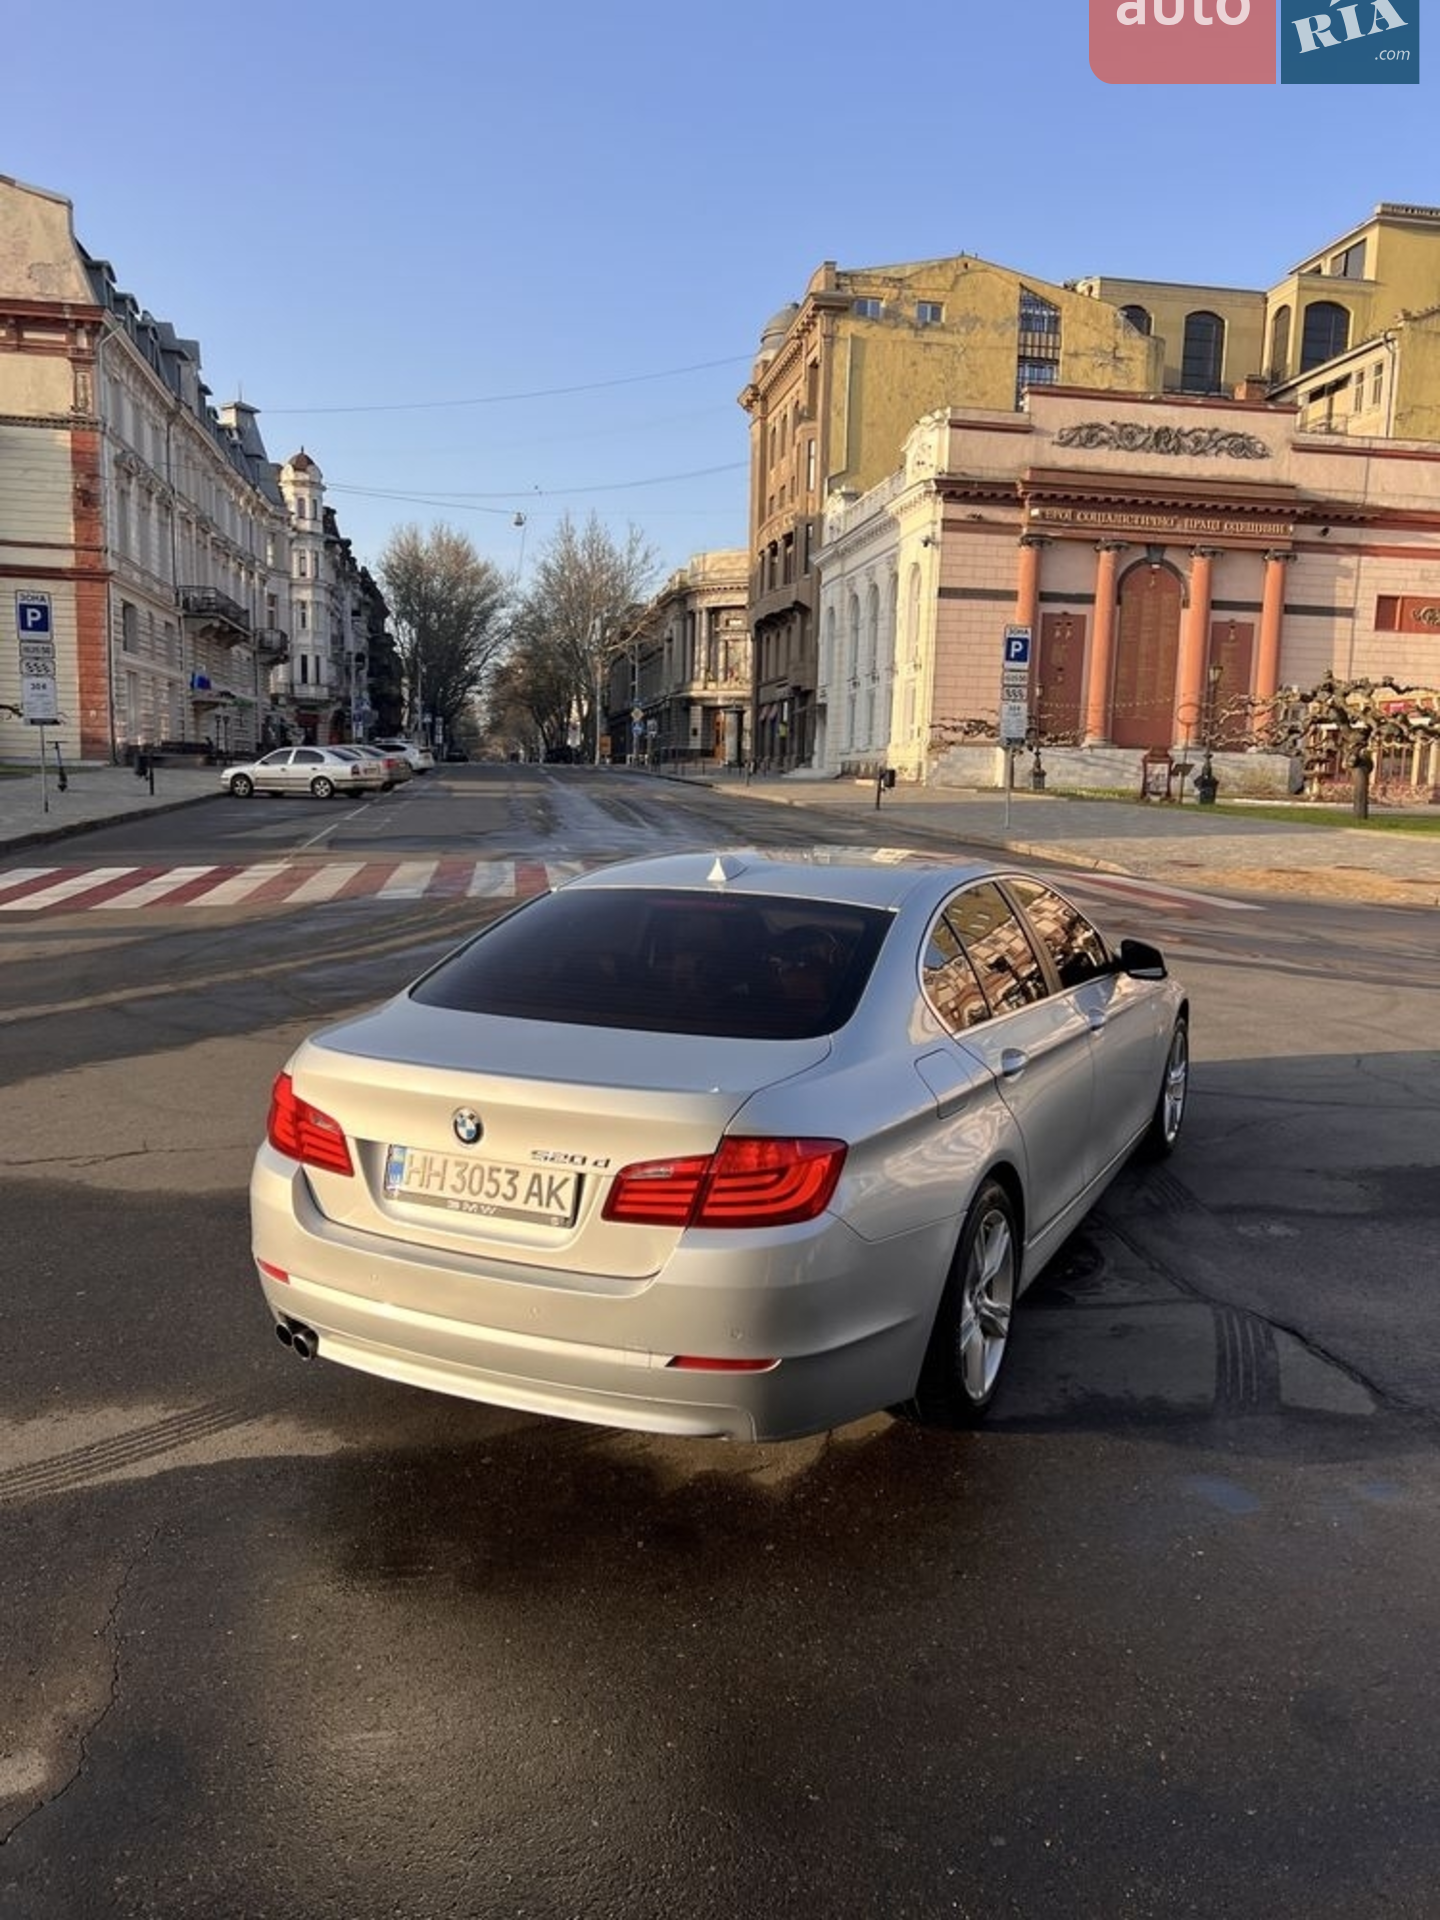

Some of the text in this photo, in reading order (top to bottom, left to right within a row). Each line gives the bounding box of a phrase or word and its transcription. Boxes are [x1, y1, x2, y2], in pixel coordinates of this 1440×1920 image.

[26, 607, 42, 629] P
[1011, 640, 1024, 659] P
[449, 1161, 521, 1202] 3053
[523, 1172, 571, 1212] AK
